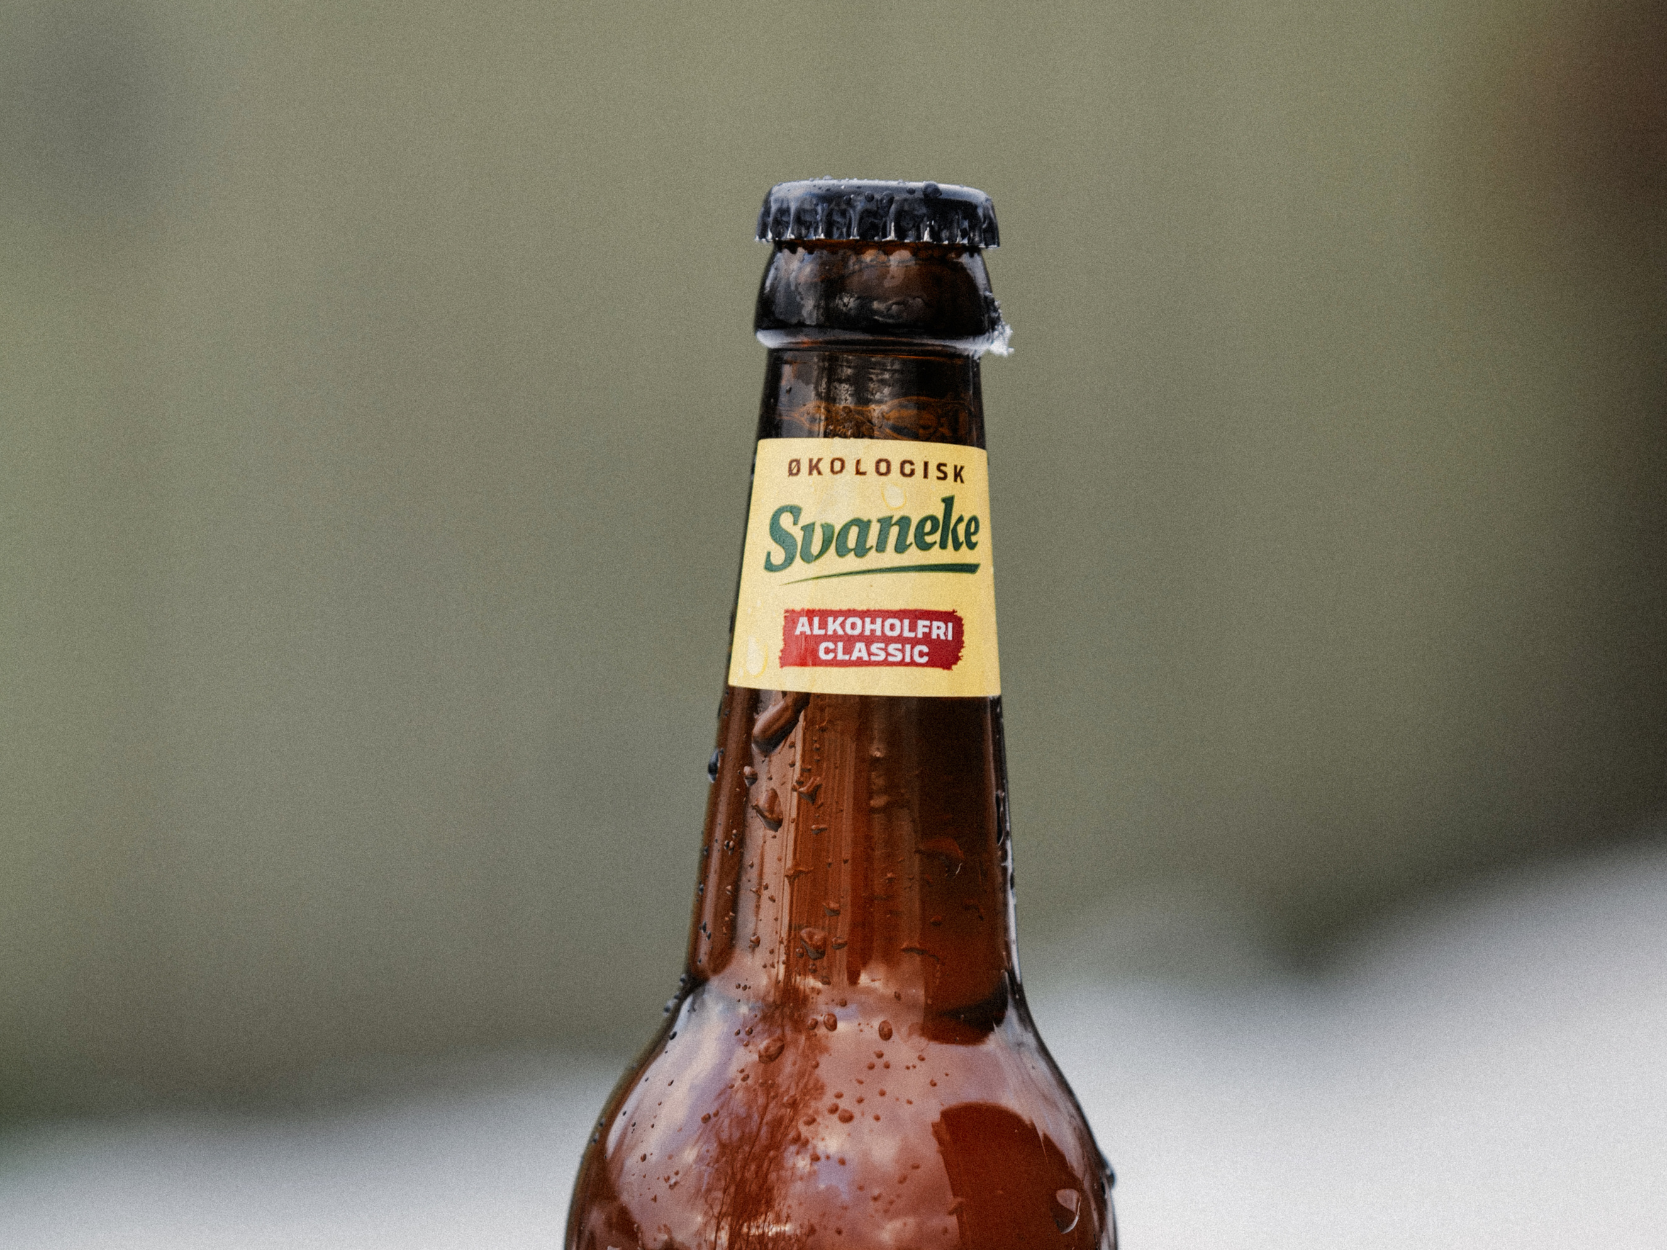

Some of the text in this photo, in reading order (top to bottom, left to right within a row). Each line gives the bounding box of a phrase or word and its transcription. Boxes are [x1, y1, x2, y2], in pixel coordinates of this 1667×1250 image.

[787, 457, 965, 484] ØKOLOGISK
[763, 494, 981, 574] Svaneke
[794, 616, 953, 640] ALKOHOLFRI
[818, 642, 929, 664] CLASSIC
